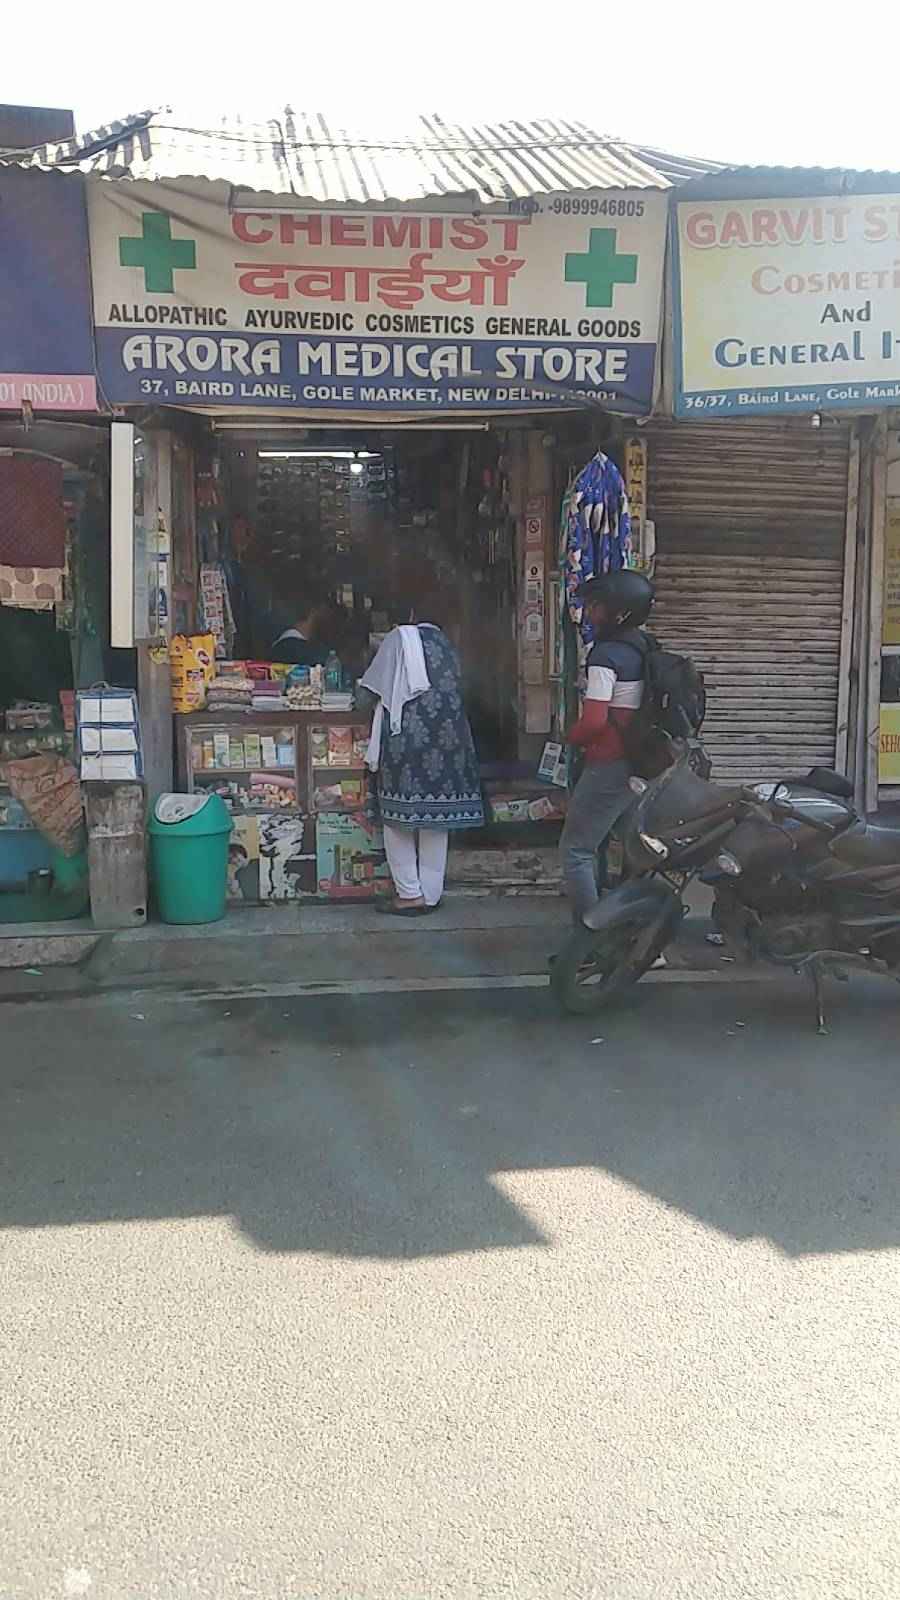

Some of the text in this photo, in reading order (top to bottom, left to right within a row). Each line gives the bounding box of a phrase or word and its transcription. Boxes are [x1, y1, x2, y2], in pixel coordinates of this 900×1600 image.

[548, 198, 644, 217] -9899946805
[231, 212, 531, 251] CHEMIST
[686, 208, 849, 244] GARVIT
[234, 252, 527, 311] दवाईयाँ
[108, 303, 642, 338] ALLOPATHIC AYURVEDIC COSMETICS GENERAL GOODS
[122, 334, 629, 386] ARORA MEDICAL STORE
[140, 379, 170, 396] 37,
[175, 380, 235, 397] BAIRD
[240, 384, 297, 400] LANE,
[303, 385, 355, 401] GOLE
[360, 386, 443, 404] MARKET,
[448, 388, 491, 401] NEW
[684, 394, 733, 409] 36/37,
